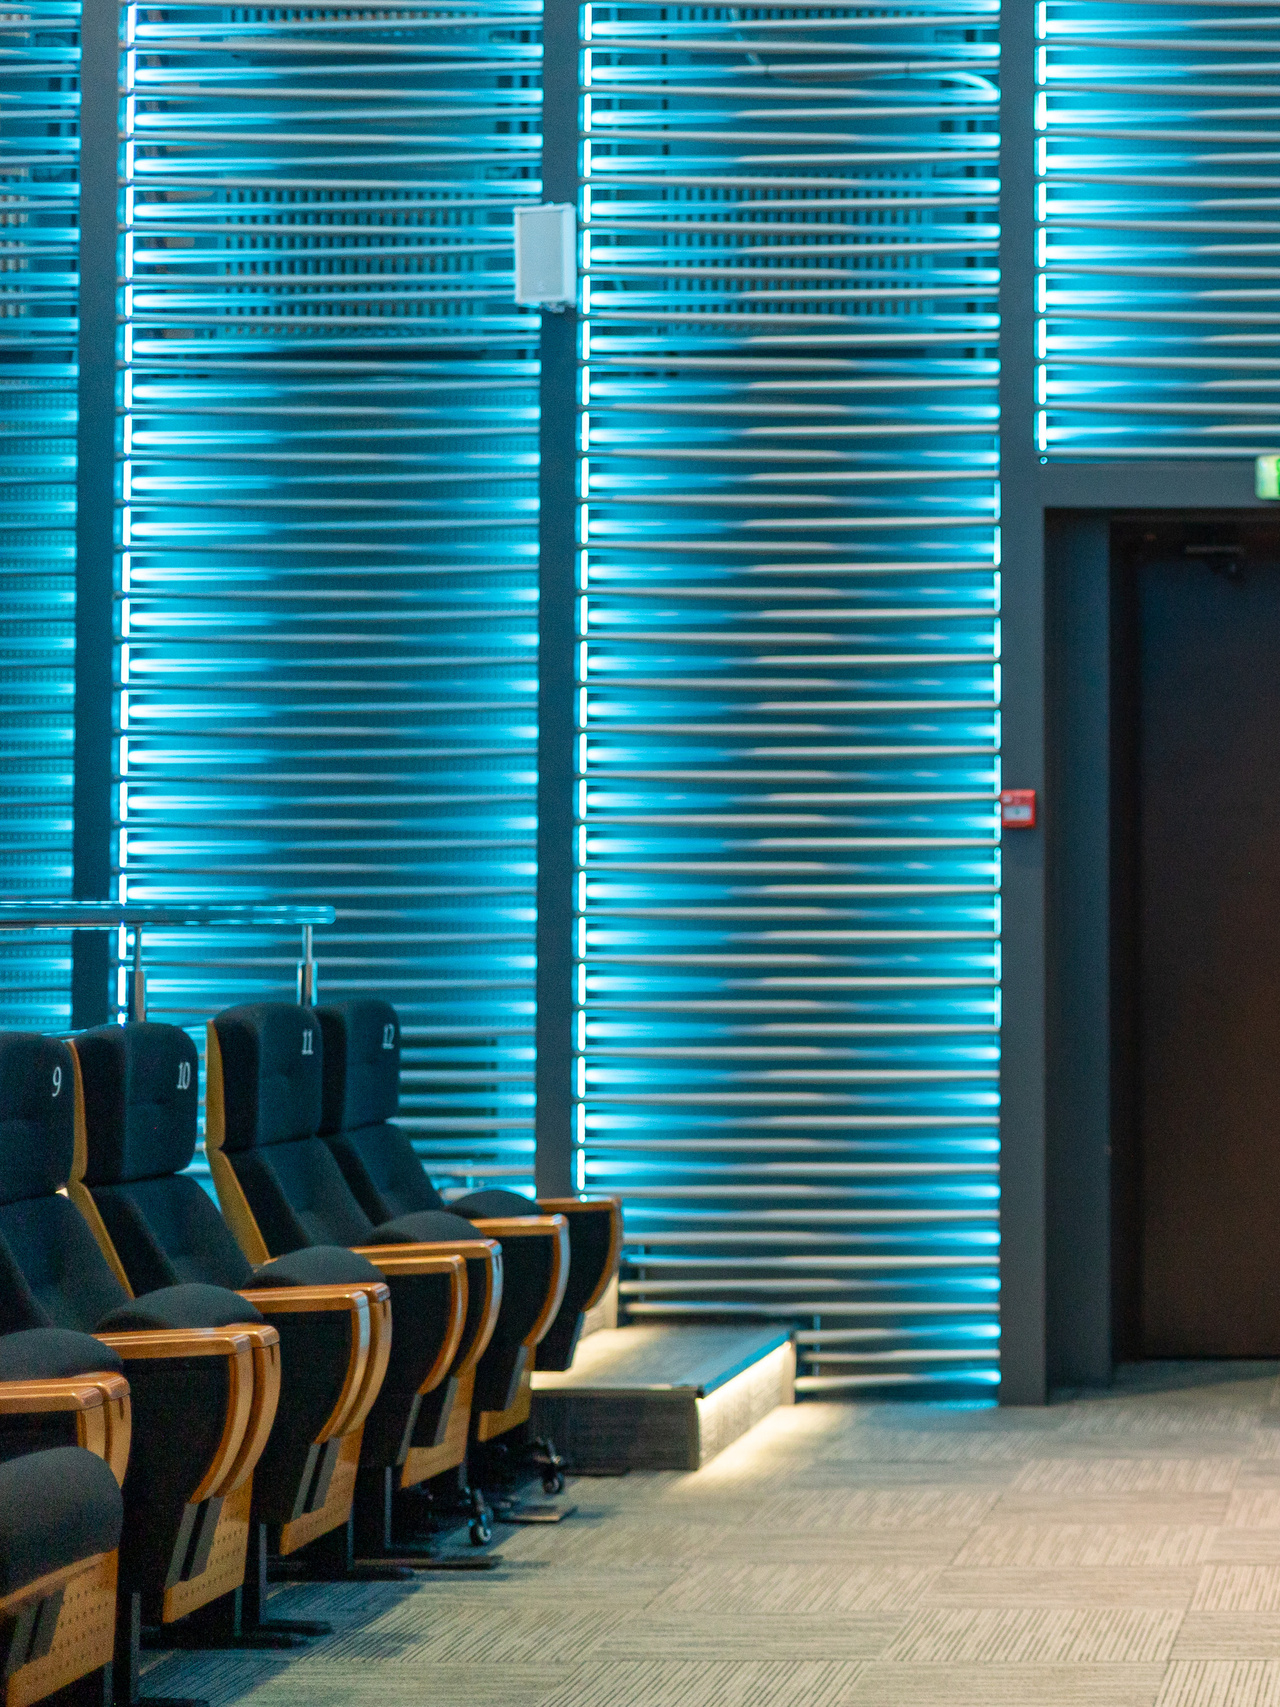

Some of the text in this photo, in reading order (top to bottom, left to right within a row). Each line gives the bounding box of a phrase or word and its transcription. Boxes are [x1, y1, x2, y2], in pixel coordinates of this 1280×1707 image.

[301, 1028, 314, 1055] 11
[382, 1023, 395, 1049] 12
[51, 1066, 62, 1097] 9
[176, 1061, 191, 1090] 10
